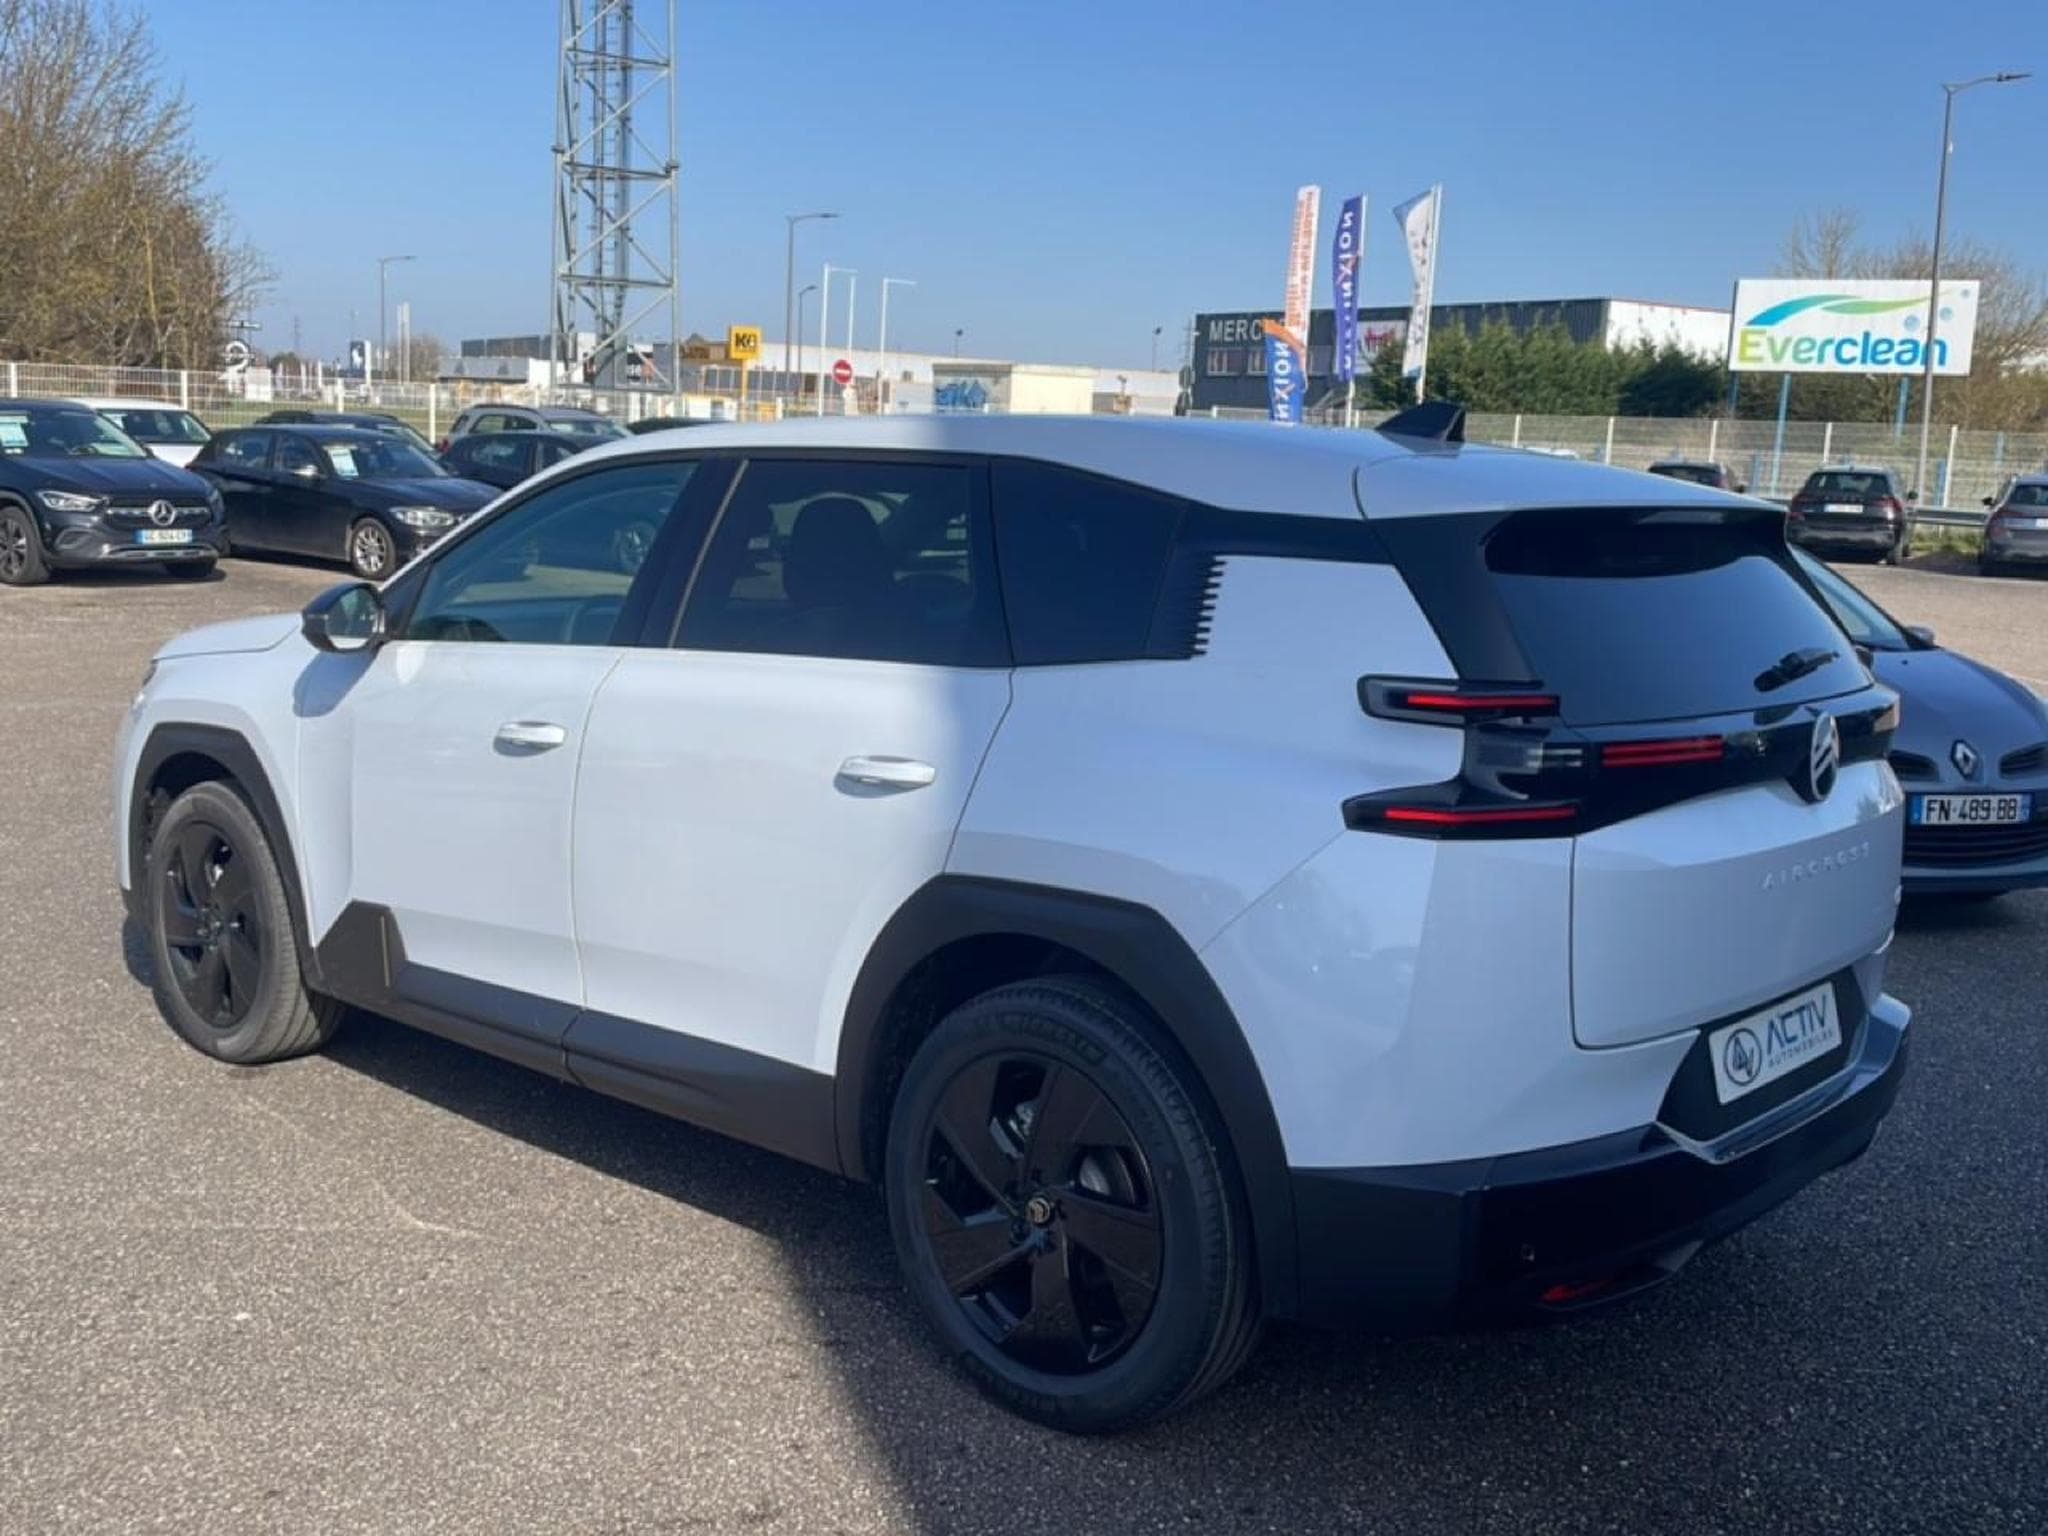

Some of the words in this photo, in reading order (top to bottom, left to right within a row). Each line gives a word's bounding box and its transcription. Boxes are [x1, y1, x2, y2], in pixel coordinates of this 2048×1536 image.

[1738, 329, 1948, 367] Everclean
[1762, 840, 1870, 890] AIRCROSS
[1767, 994, 1828, 1055] ACTIV
